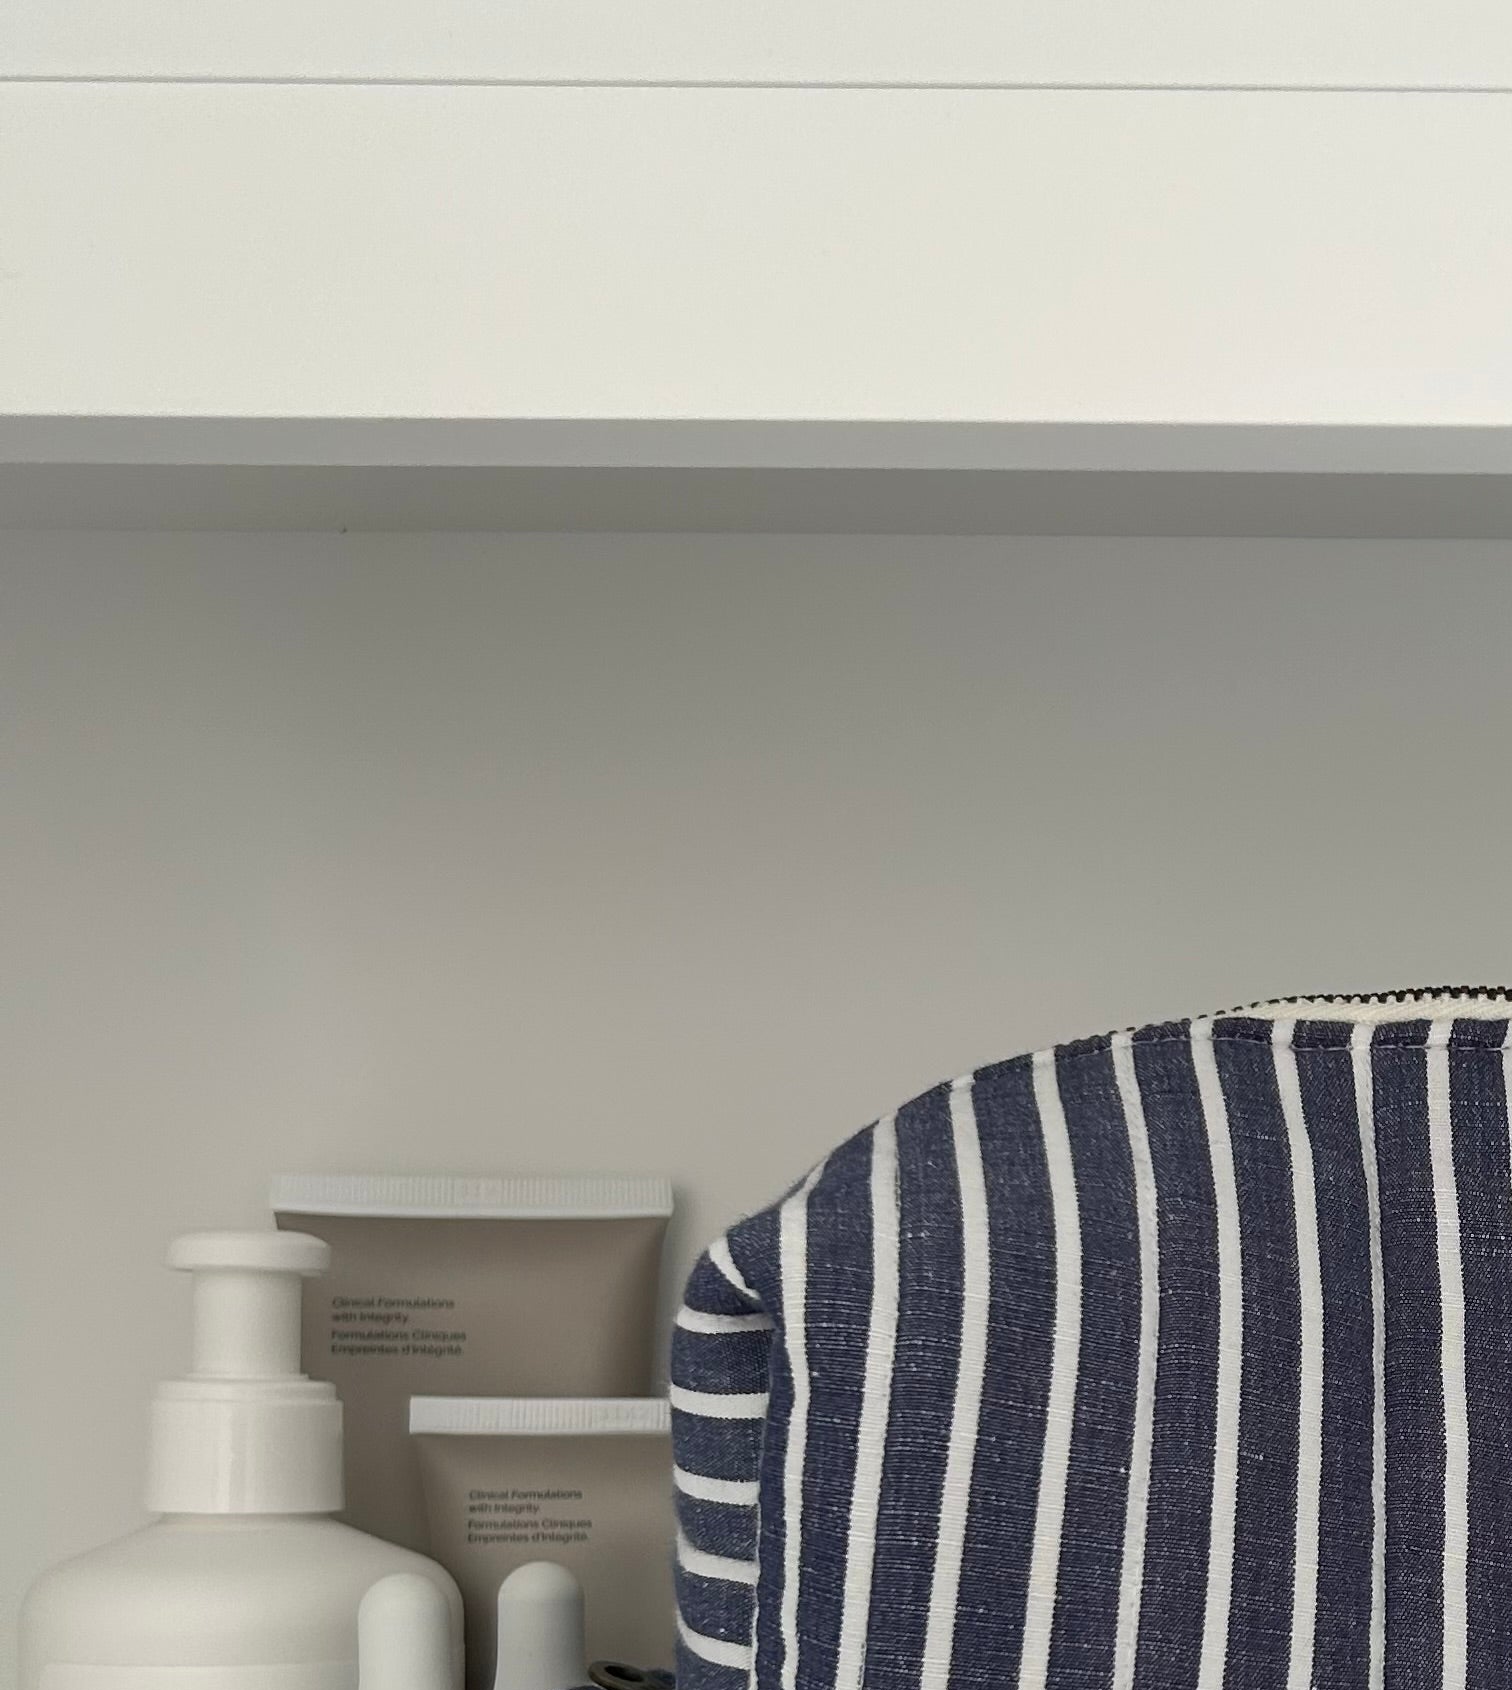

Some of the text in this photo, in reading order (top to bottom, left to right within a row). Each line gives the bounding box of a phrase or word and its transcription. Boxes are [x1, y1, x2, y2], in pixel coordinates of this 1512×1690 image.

[511, 1489, 583, 1500] Formulations
[468, 1503, 492, 1514] with
[467, 1518, 593, 1531] Formulations Cliniques
